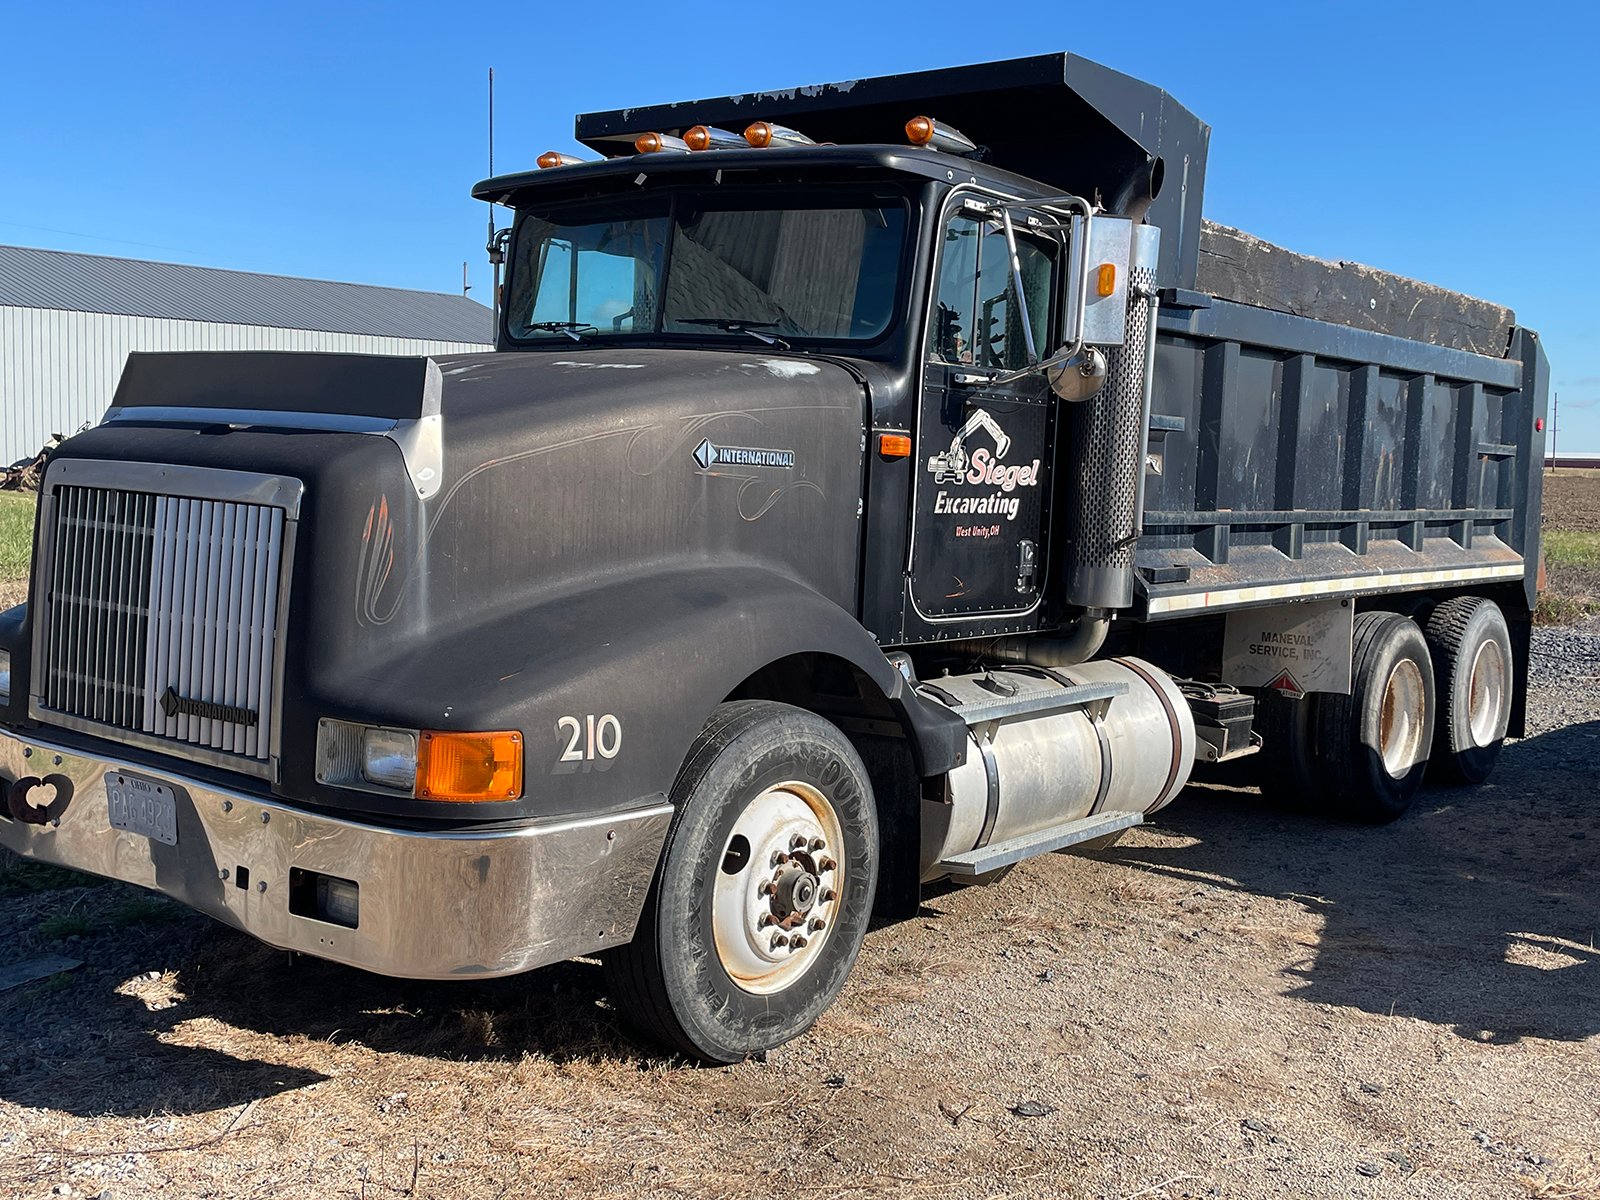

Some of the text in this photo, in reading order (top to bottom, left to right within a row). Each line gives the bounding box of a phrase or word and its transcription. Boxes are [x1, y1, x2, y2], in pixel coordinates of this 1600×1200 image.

[719, 448, 794, 466] INTERNATIONAL
[966, 447, 1040, 492] Siegel
[933, 490, 1020, 520] Excavating
[956, 525, 971, 537] West
[1261, 631, 1313, 647] MANEVAL
[1249, 643, 1299, 660] SERVICE,
[179, 698, 257, 726] INTERNATIONAL
[557, 713, 622, 762] 210
